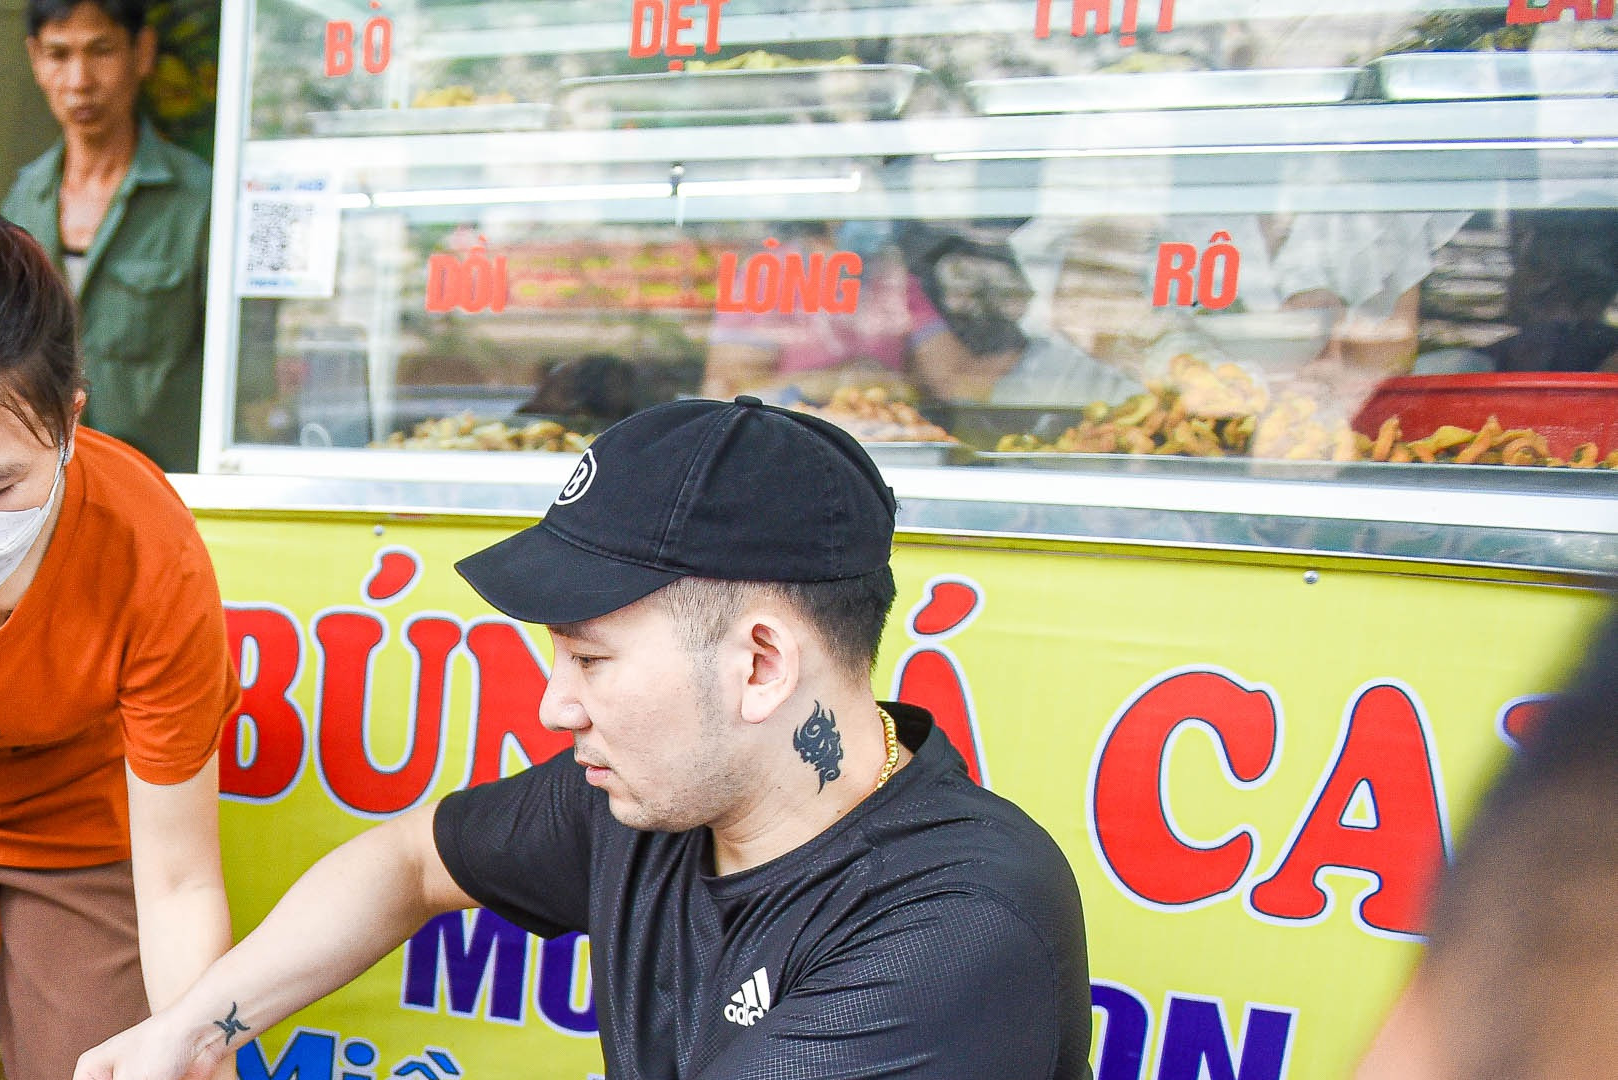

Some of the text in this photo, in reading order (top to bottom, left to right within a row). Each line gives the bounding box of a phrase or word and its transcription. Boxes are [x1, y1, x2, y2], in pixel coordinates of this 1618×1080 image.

[628, 0, 732, 72] DẸT
[715, 236, 864, 315] LÒNG
[1152, 230, 1241, 311] RÔ
